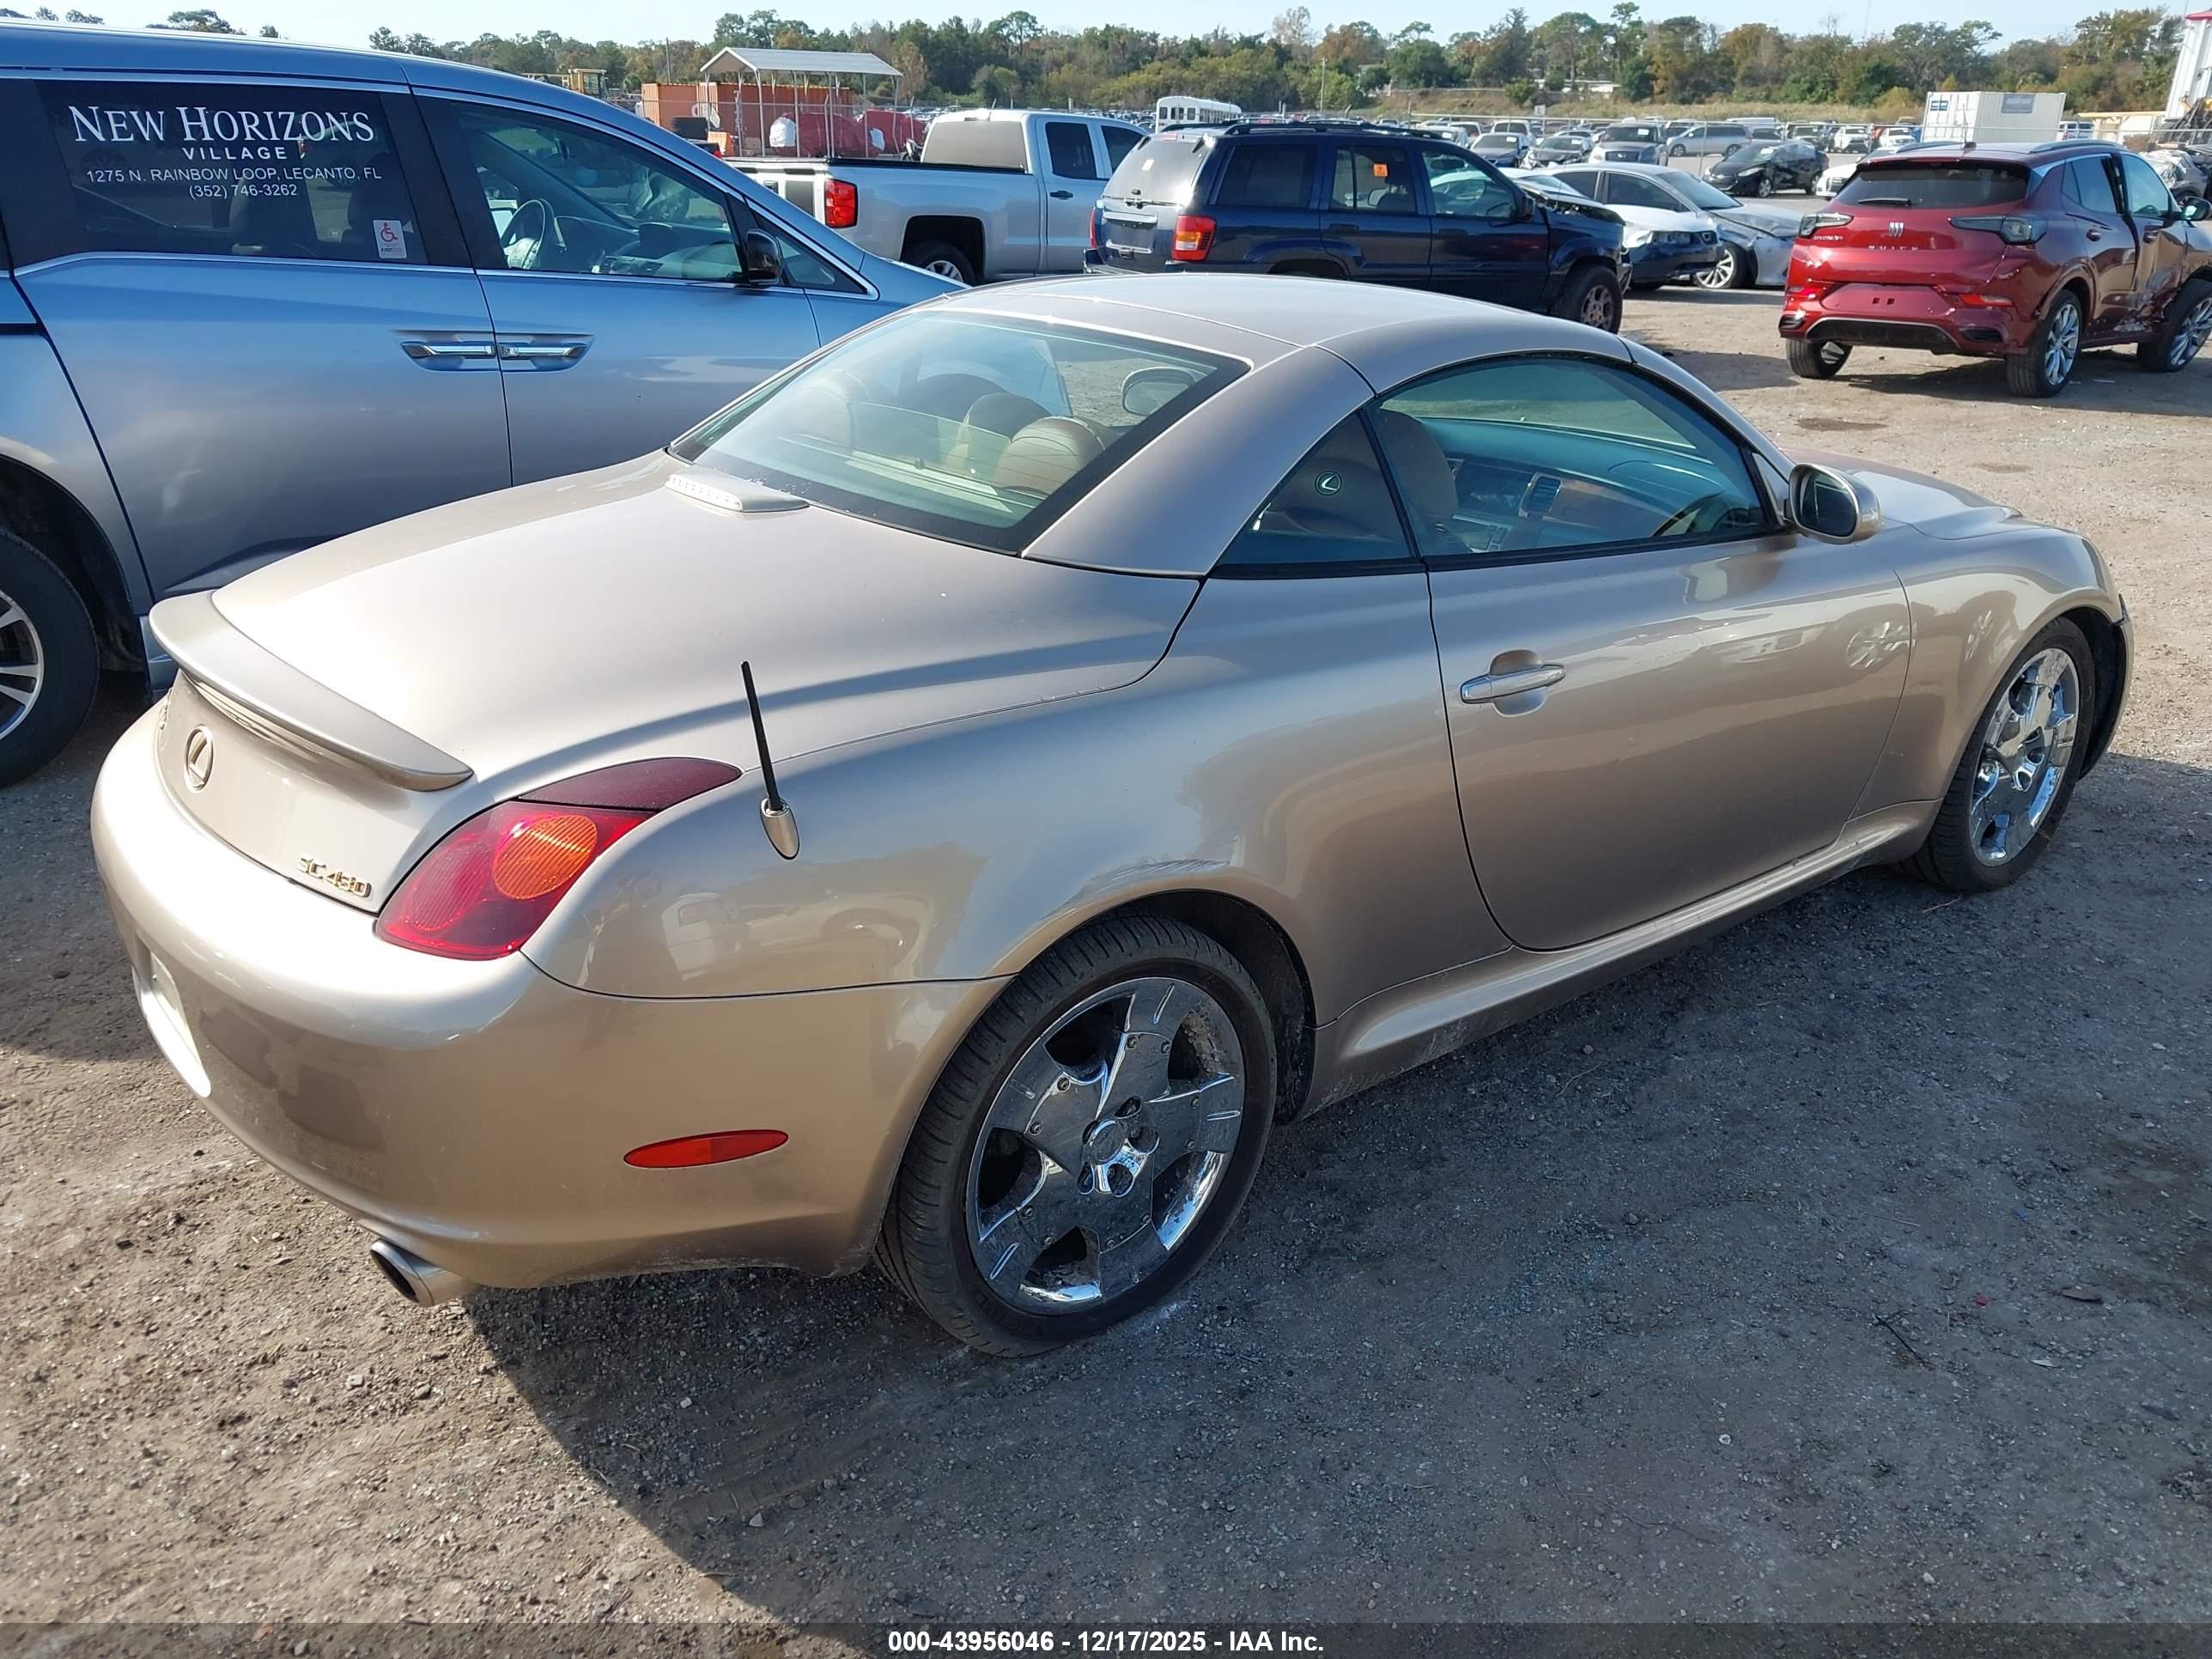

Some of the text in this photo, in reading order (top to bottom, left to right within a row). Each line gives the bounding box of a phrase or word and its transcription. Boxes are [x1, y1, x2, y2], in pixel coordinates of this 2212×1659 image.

[68, 106, 374, 142] NEW HORIZONS
[181, 147, 288, 160] VILLAGE
[87, 167, 383, 183] 1275 N. RAINBOW LOOP, LECANTO, FL
[189, 184, 298, 200] (352) 746-3262
